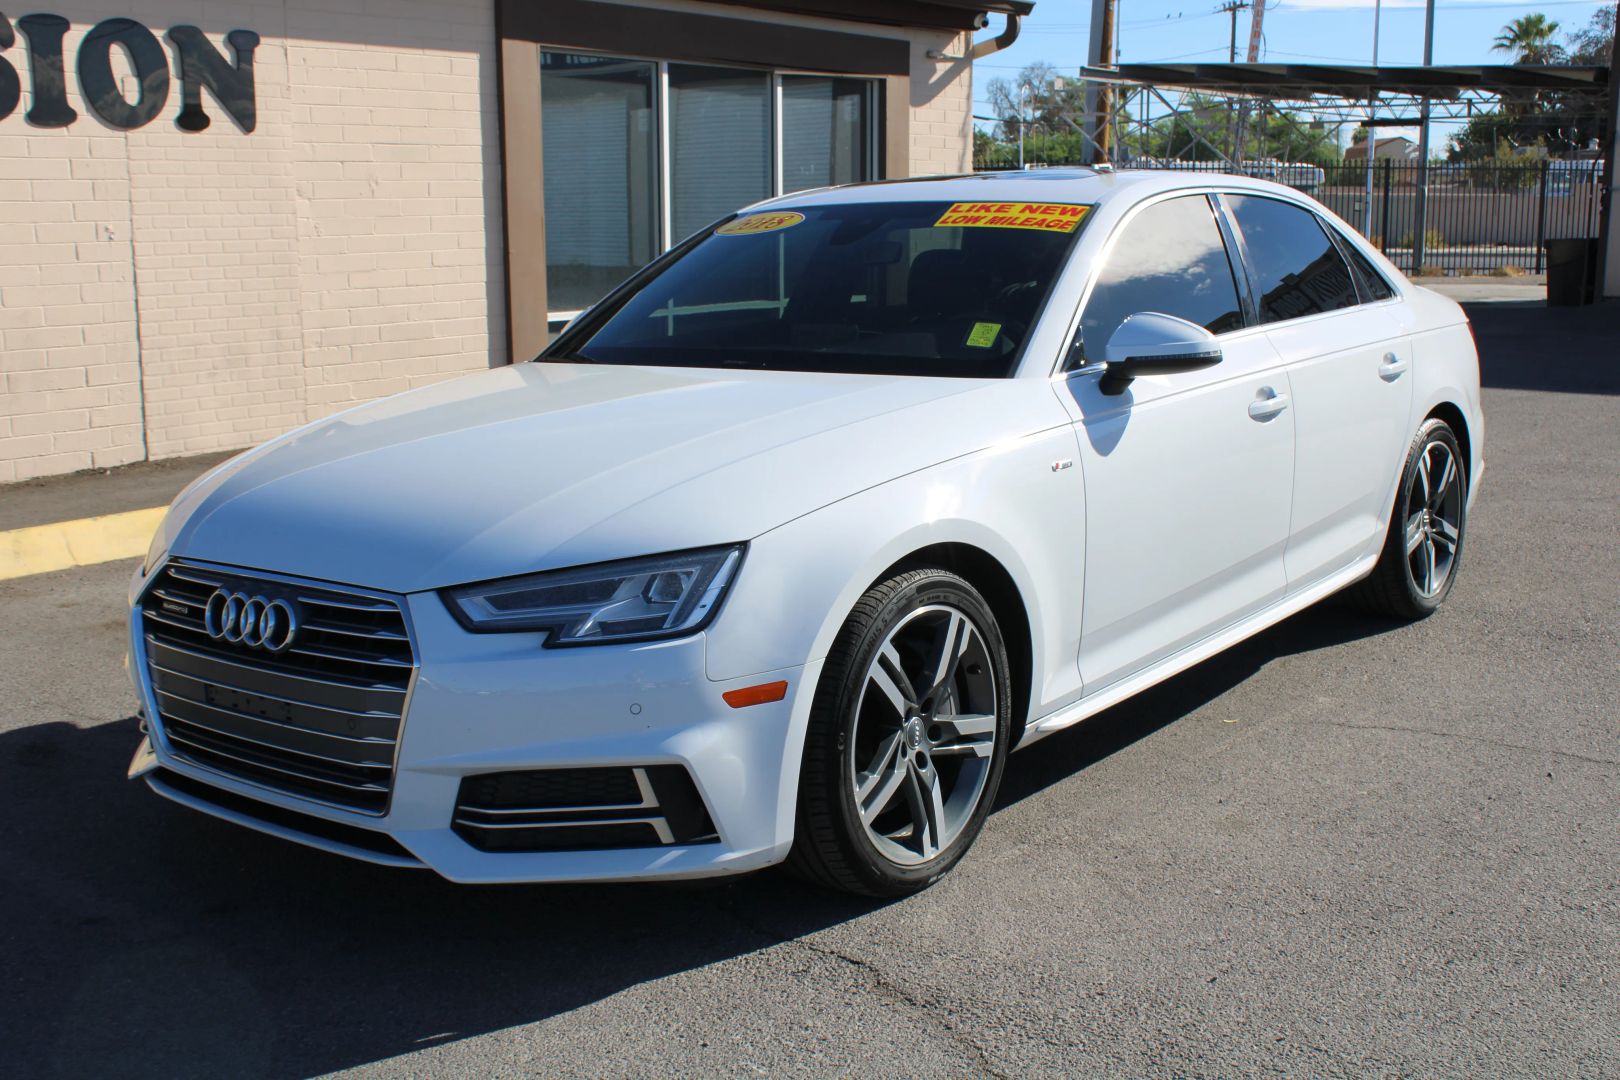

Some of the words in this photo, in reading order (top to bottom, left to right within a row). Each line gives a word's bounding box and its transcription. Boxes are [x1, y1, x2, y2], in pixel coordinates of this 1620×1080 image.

[950, 204, 1016, 214] LIKE
[1019, 205, 1086, 217] NEW
[939, 215, 987, 225] LOW
[985, 216, 1078, 230] MILEAGE
